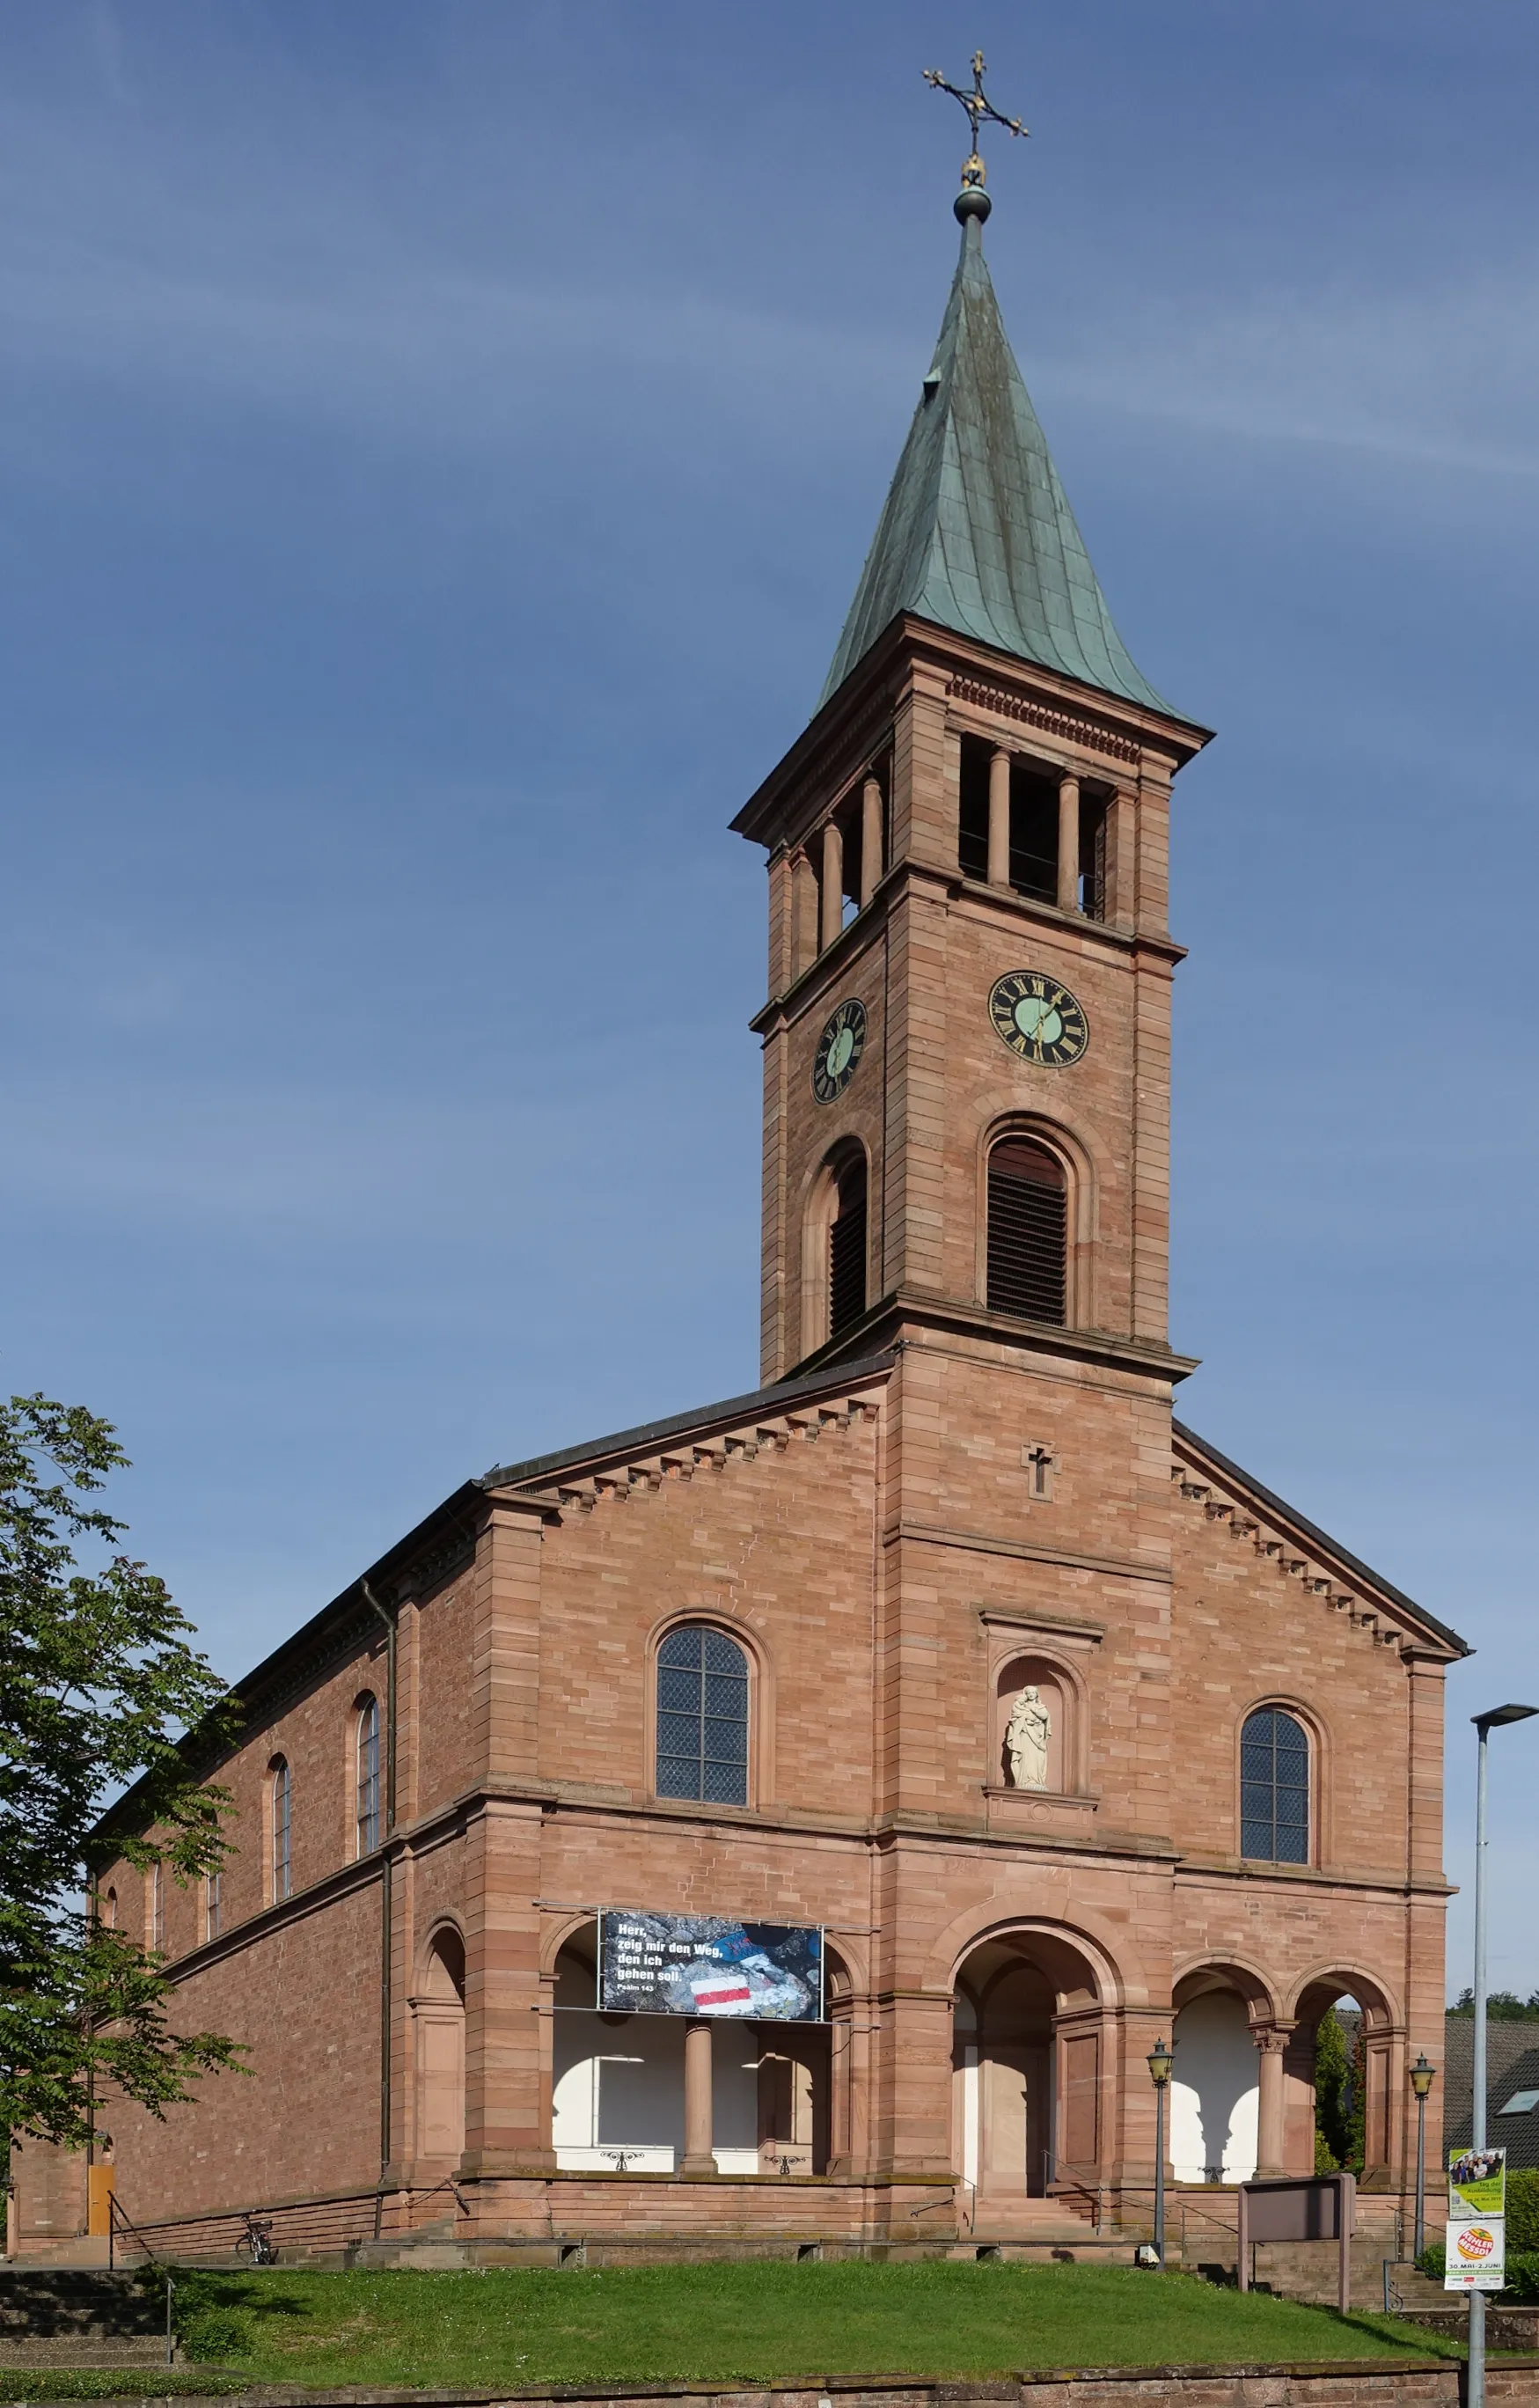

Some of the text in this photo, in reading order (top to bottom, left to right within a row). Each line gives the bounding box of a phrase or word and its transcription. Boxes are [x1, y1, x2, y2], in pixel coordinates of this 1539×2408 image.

[619, 1923, 647, 1938] Herr,
[617, 1939, 723, 1958] zeig mir den Weg,
[618, 1953, 662, 1966] den ich
[617, 1968, 682, 1982] gehen soll.
[1458, 2238, 1489, 2256] MESSDI
[1462, 2231, 1494, 2249] KEHLER
